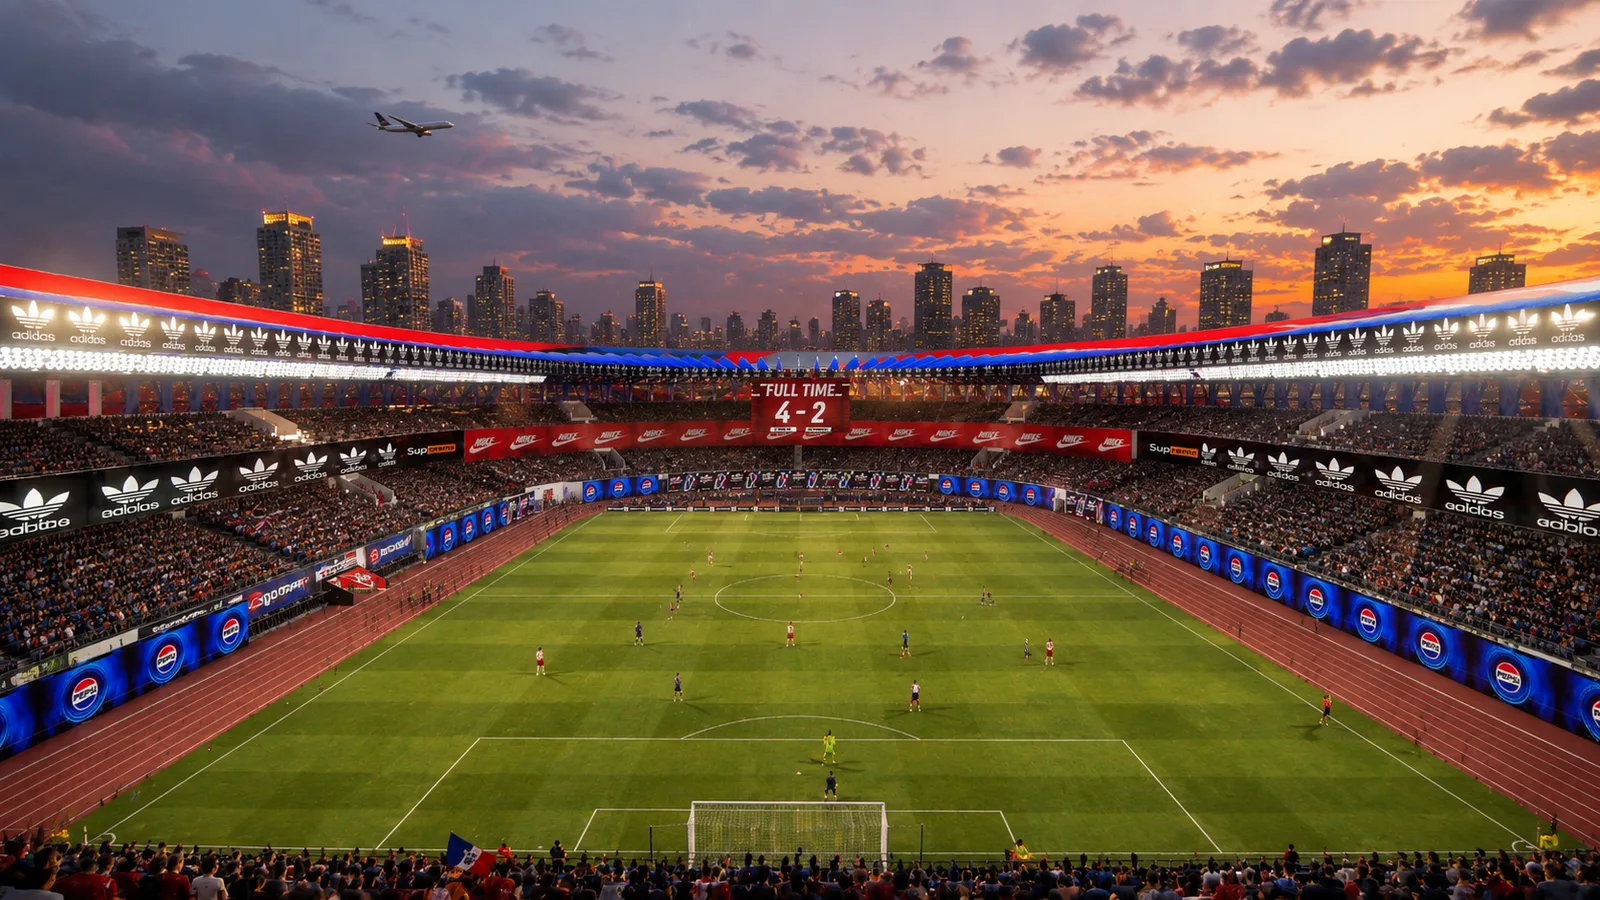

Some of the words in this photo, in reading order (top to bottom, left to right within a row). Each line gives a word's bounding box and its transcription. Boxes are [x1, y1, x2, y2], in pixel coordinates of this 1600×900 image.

[12, 330, 55, 342] adidas
[766, 384, 798, 396] FULL
[803, 383, 836, 396] TIME
[774, 401, 790, 423] 4
[811, 401, 826, 423] 2
[171, 490, 218, 505] adidas
[1375, 490, 1422, 504] adidas
